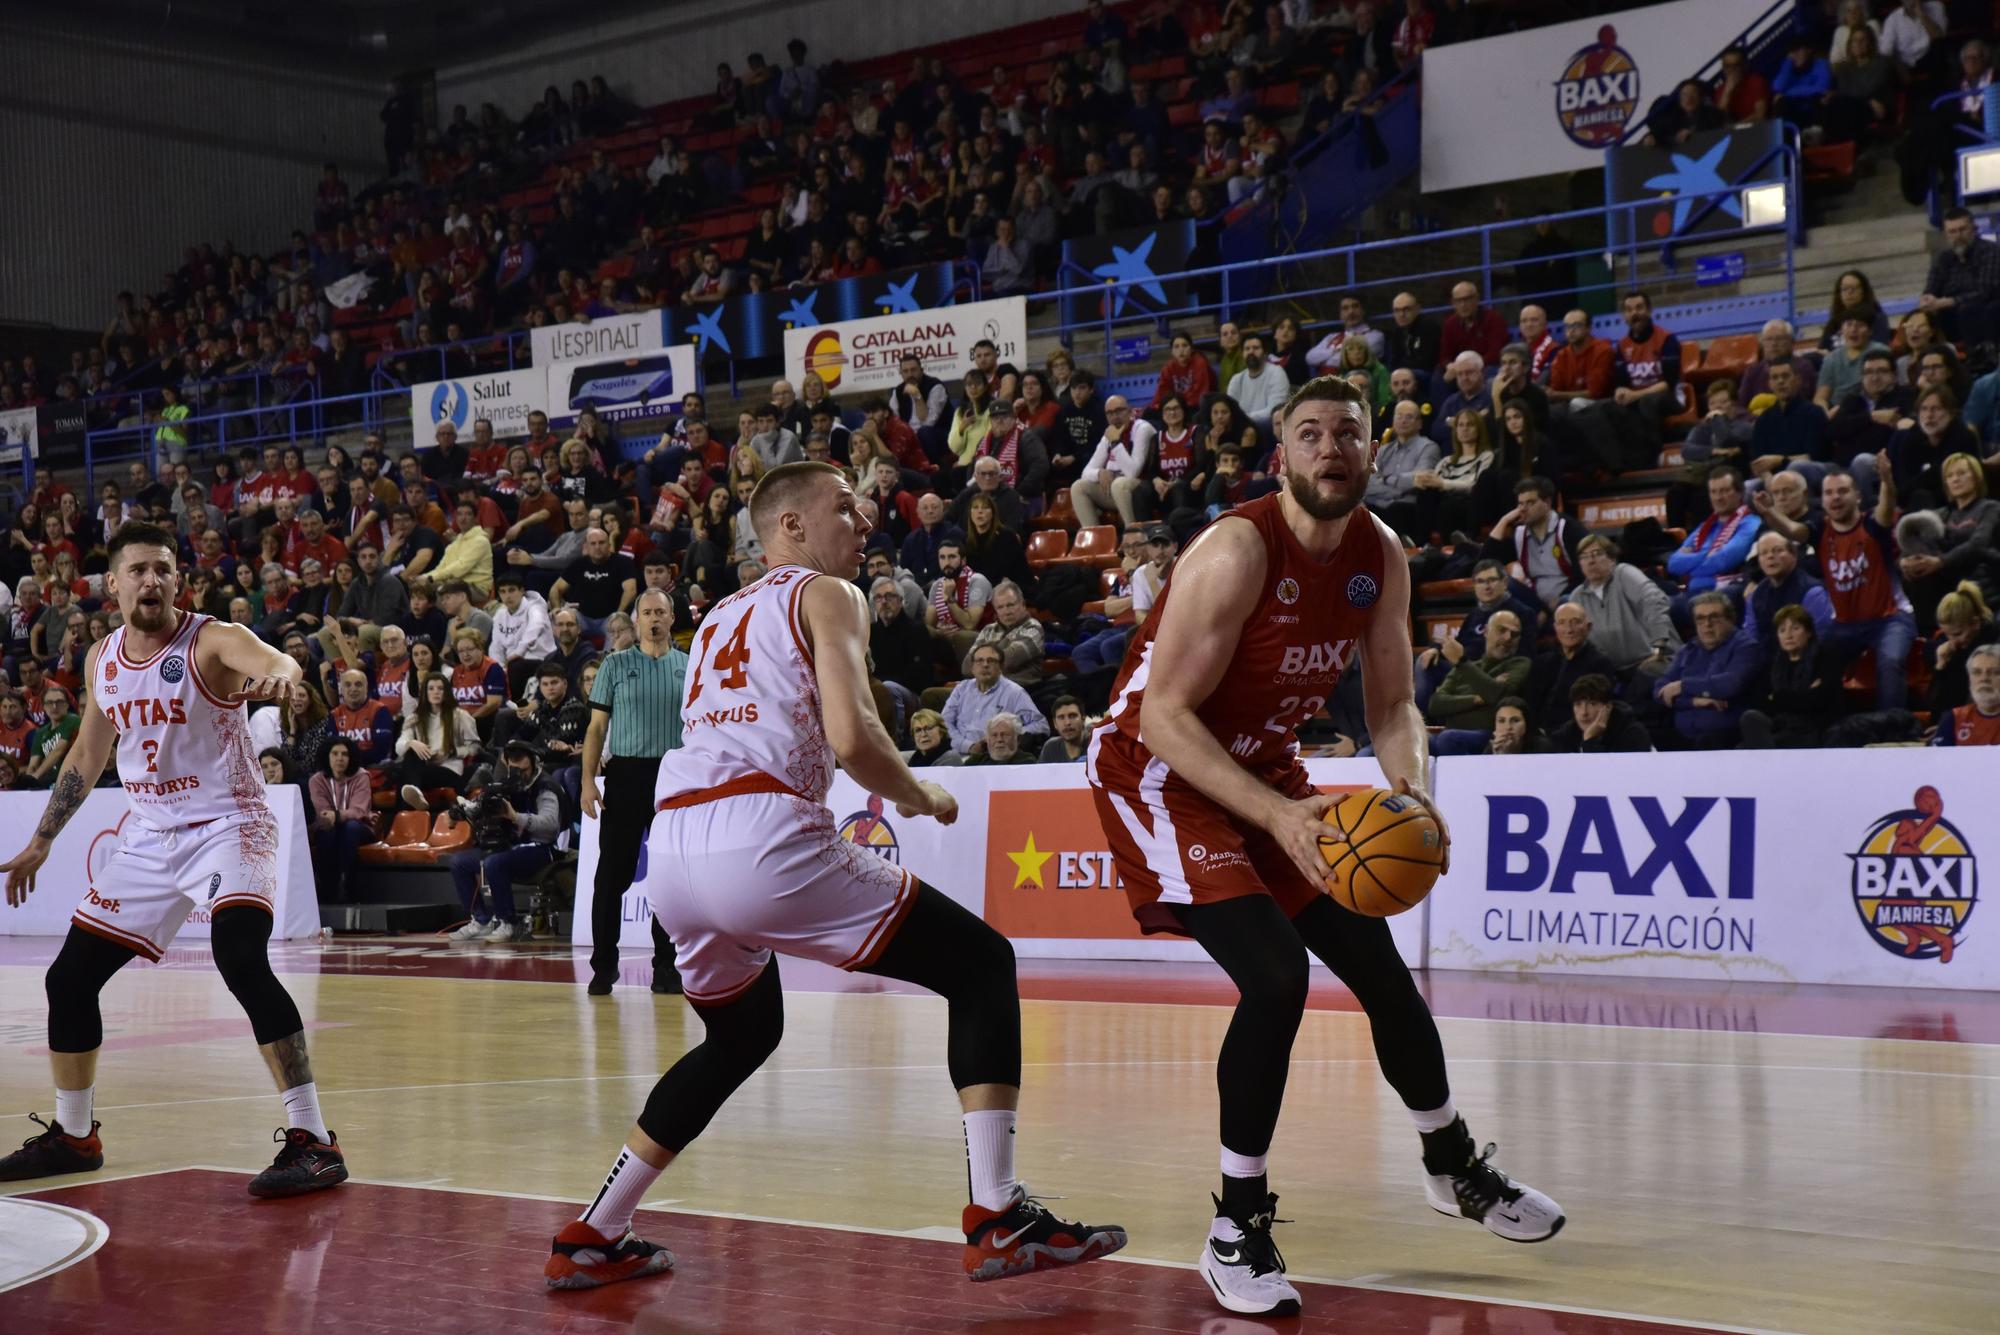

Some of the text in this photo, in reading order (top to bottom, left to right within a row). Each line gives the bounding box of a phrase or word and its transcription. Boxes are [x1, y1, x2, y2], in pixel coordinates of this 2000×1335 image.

[1560, 70, 1637, 110] BAXI
[852, 322, 955, 349] CATALANA
[853, 351, 875, 369] DE
[879, 341, 958, 366] TREBALL
[473, 379, 512, 400] Salut
[474, 403, 530, 422] Manresa
[685, 603, 755, 709] 14
[1278, 639, 1354, 675] BAX
[106, 698, 187, 733] RYTAS
[142, 739, 159, 772] 2
[1484, 795, 1756, 900] BAXI
[1856, 856, 1974, 899] BAXI
[1484, 906, 1754, 952] CLIMATIZACIÓN
[1877, 905, 1955, 928] MANRESA
